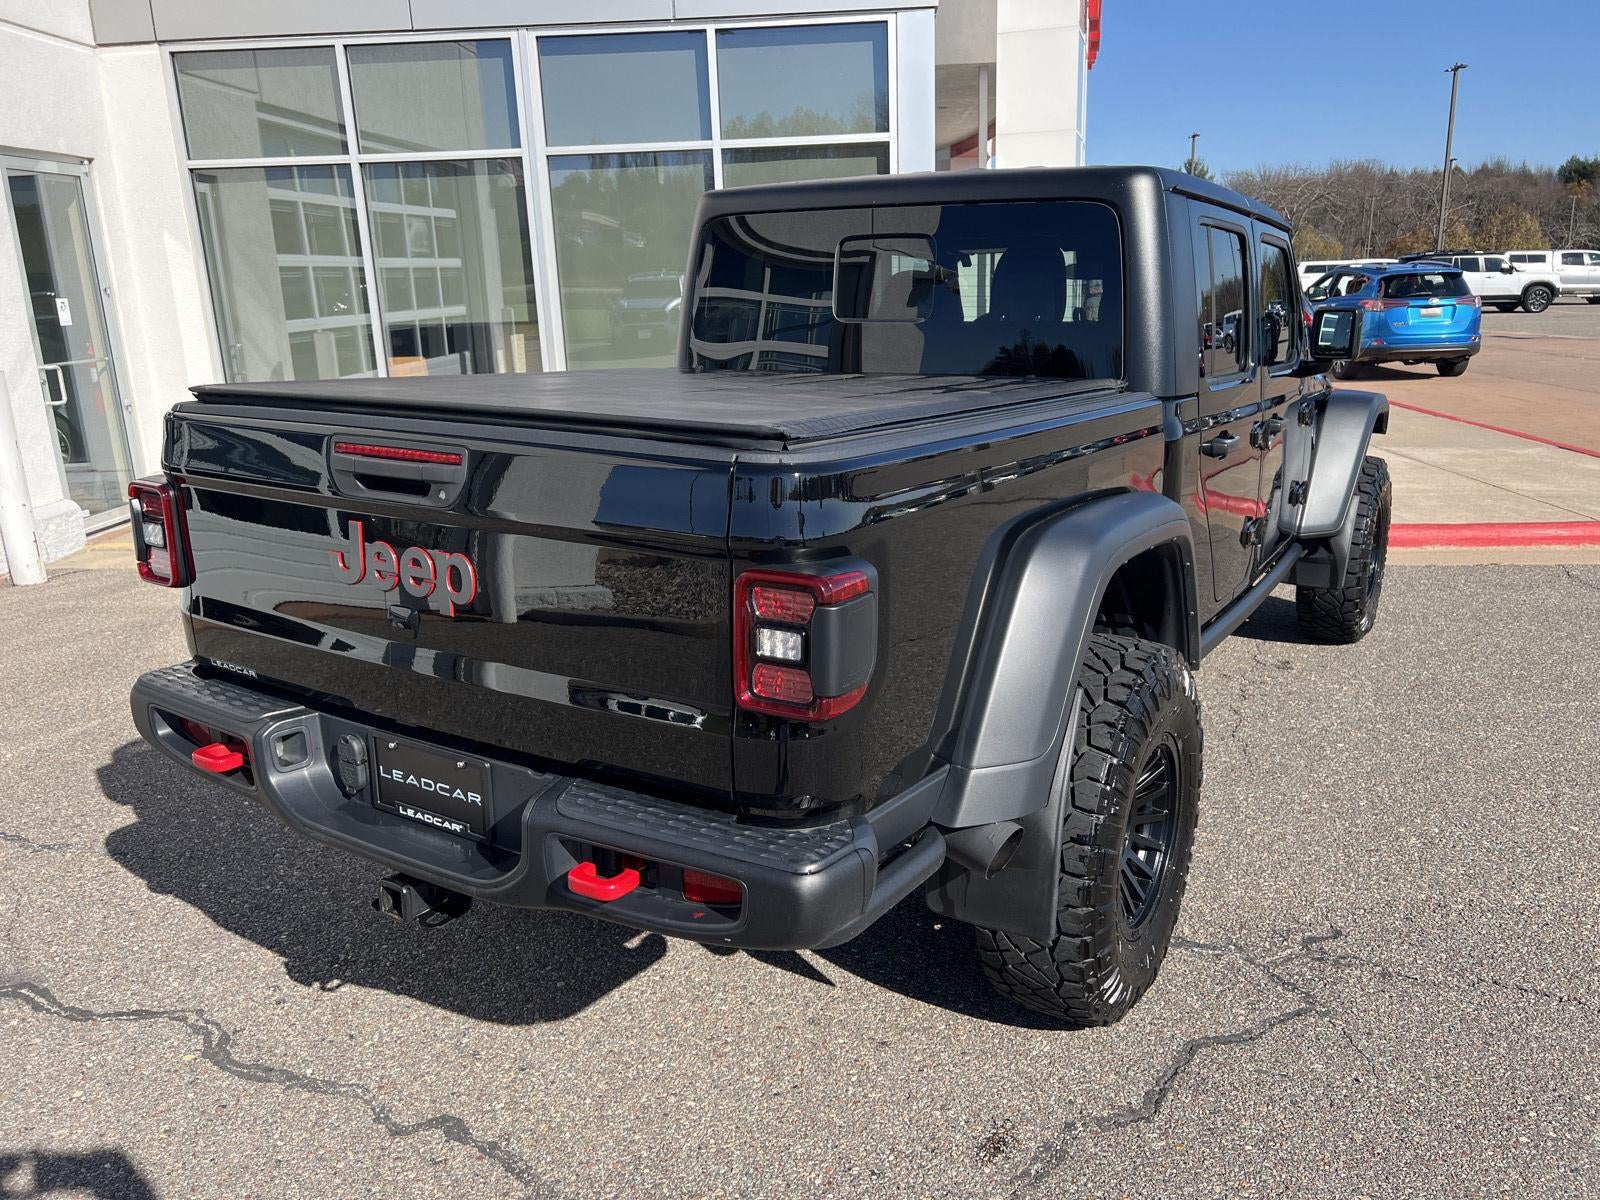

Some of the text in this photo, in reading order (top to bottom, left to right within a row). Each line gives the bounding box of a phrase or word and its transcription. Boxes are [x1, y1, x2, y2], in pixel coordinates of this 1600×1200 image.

[329, 519, 477, 617] Jeep
[210, 657, 258, 679] LEADCAR
[379, 765, 482, 806] LEADCAR
[399, 805, 463, 832] LEADCAR
